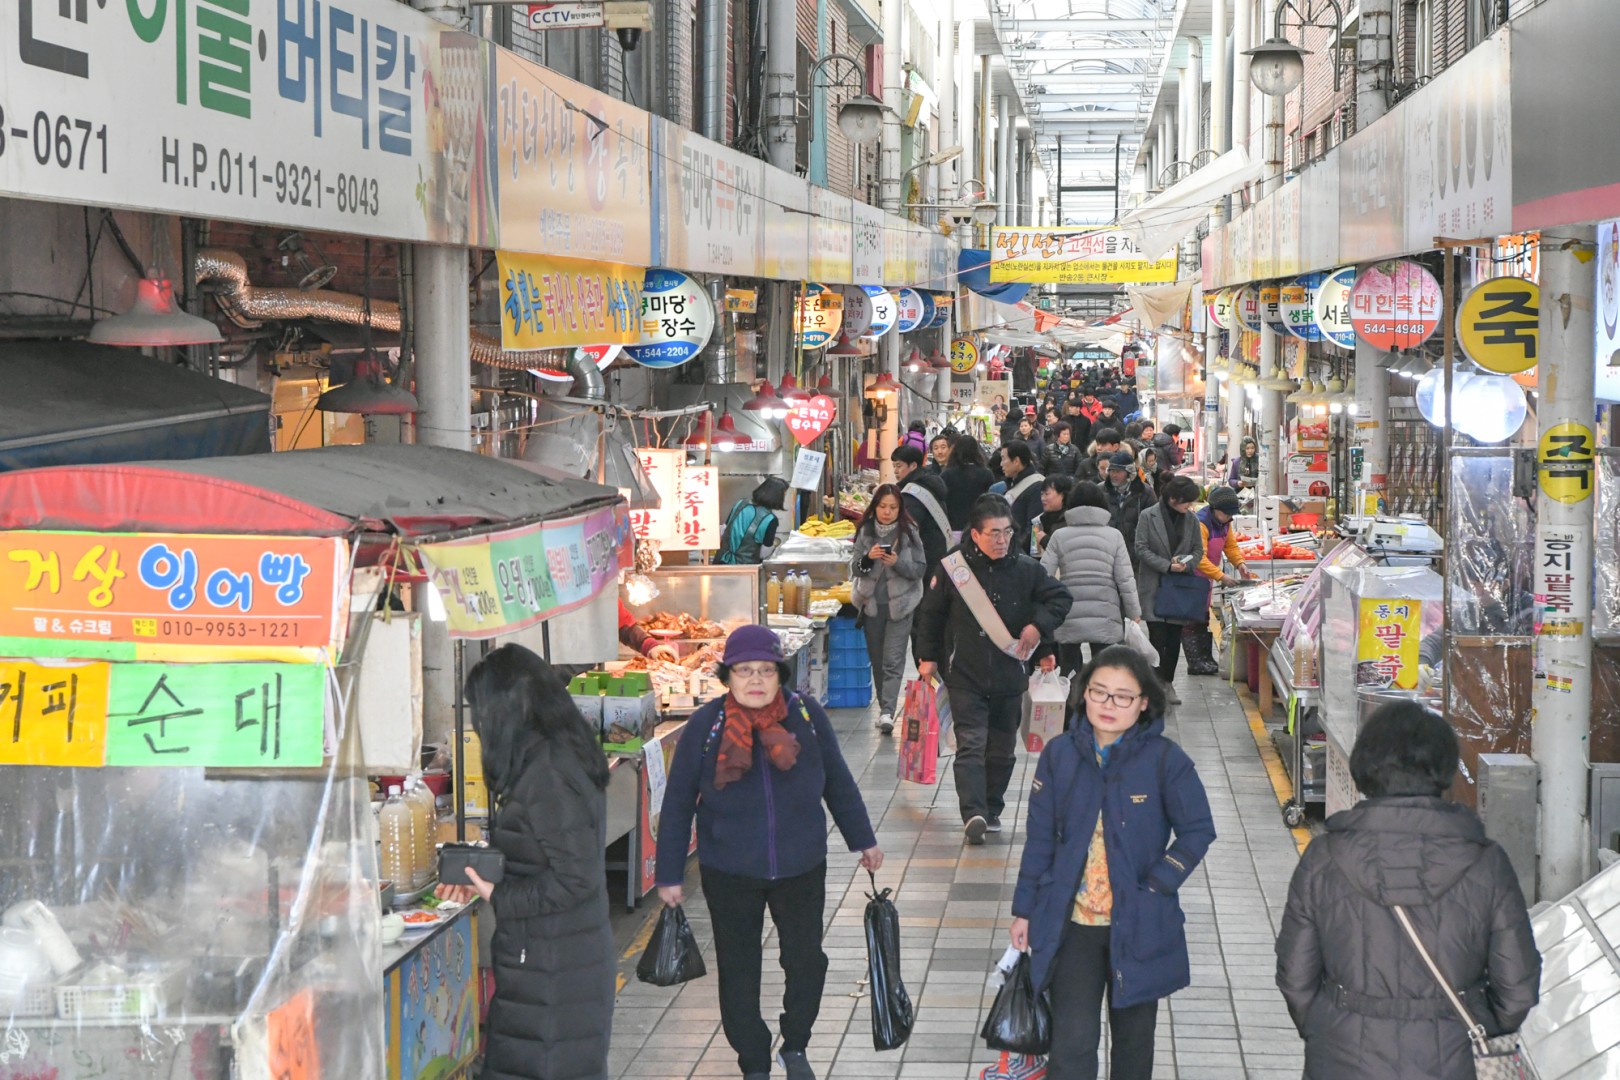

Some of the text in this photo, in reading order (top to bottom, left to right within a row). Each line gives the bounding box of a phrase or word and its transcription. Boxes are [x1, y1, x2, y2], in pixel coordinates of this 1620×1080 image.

[532, 10, 570, 24] CCTV
[277, 0, 415, 156] 버티칼
[500, 77, 576, 192] 장터한방
[162, 136, 379, 216] H.P.011-9321-8043
[996, 232, 1028, 259] 선!
[1067, 236, 1118, 255] 고객선을
[1119, 261, 1136, 270] 사지도
[504, 268, 544, 336] 저희는
[542, 272, 578, 333] 국내산
[576, 273, 605, 333] 생족만
[1288, 309, 1315, 323] 생닭
[1354, 294, 1436, 314] 대한축산
[1363, 323, 1425, 335] 544-4948
[1473, 291, 1539, 359] 죽
[635, 347, 689, 359] T.544-2204
[1545, 434, 1593, 490] 죽
[683, 491, 706, 546] 족발
[8, 543, 311, 612] 거상 잉어빵
[498, 557, 526, 605] 오뎅
[51, 618, 66, 632] &
[69, 618, 112, 635] 슈크림
[163, 620, 300, 637] 010-9953-1221
[1374, 604, 1410, 620] 동지
[127, 672, 282, 760] 순대
